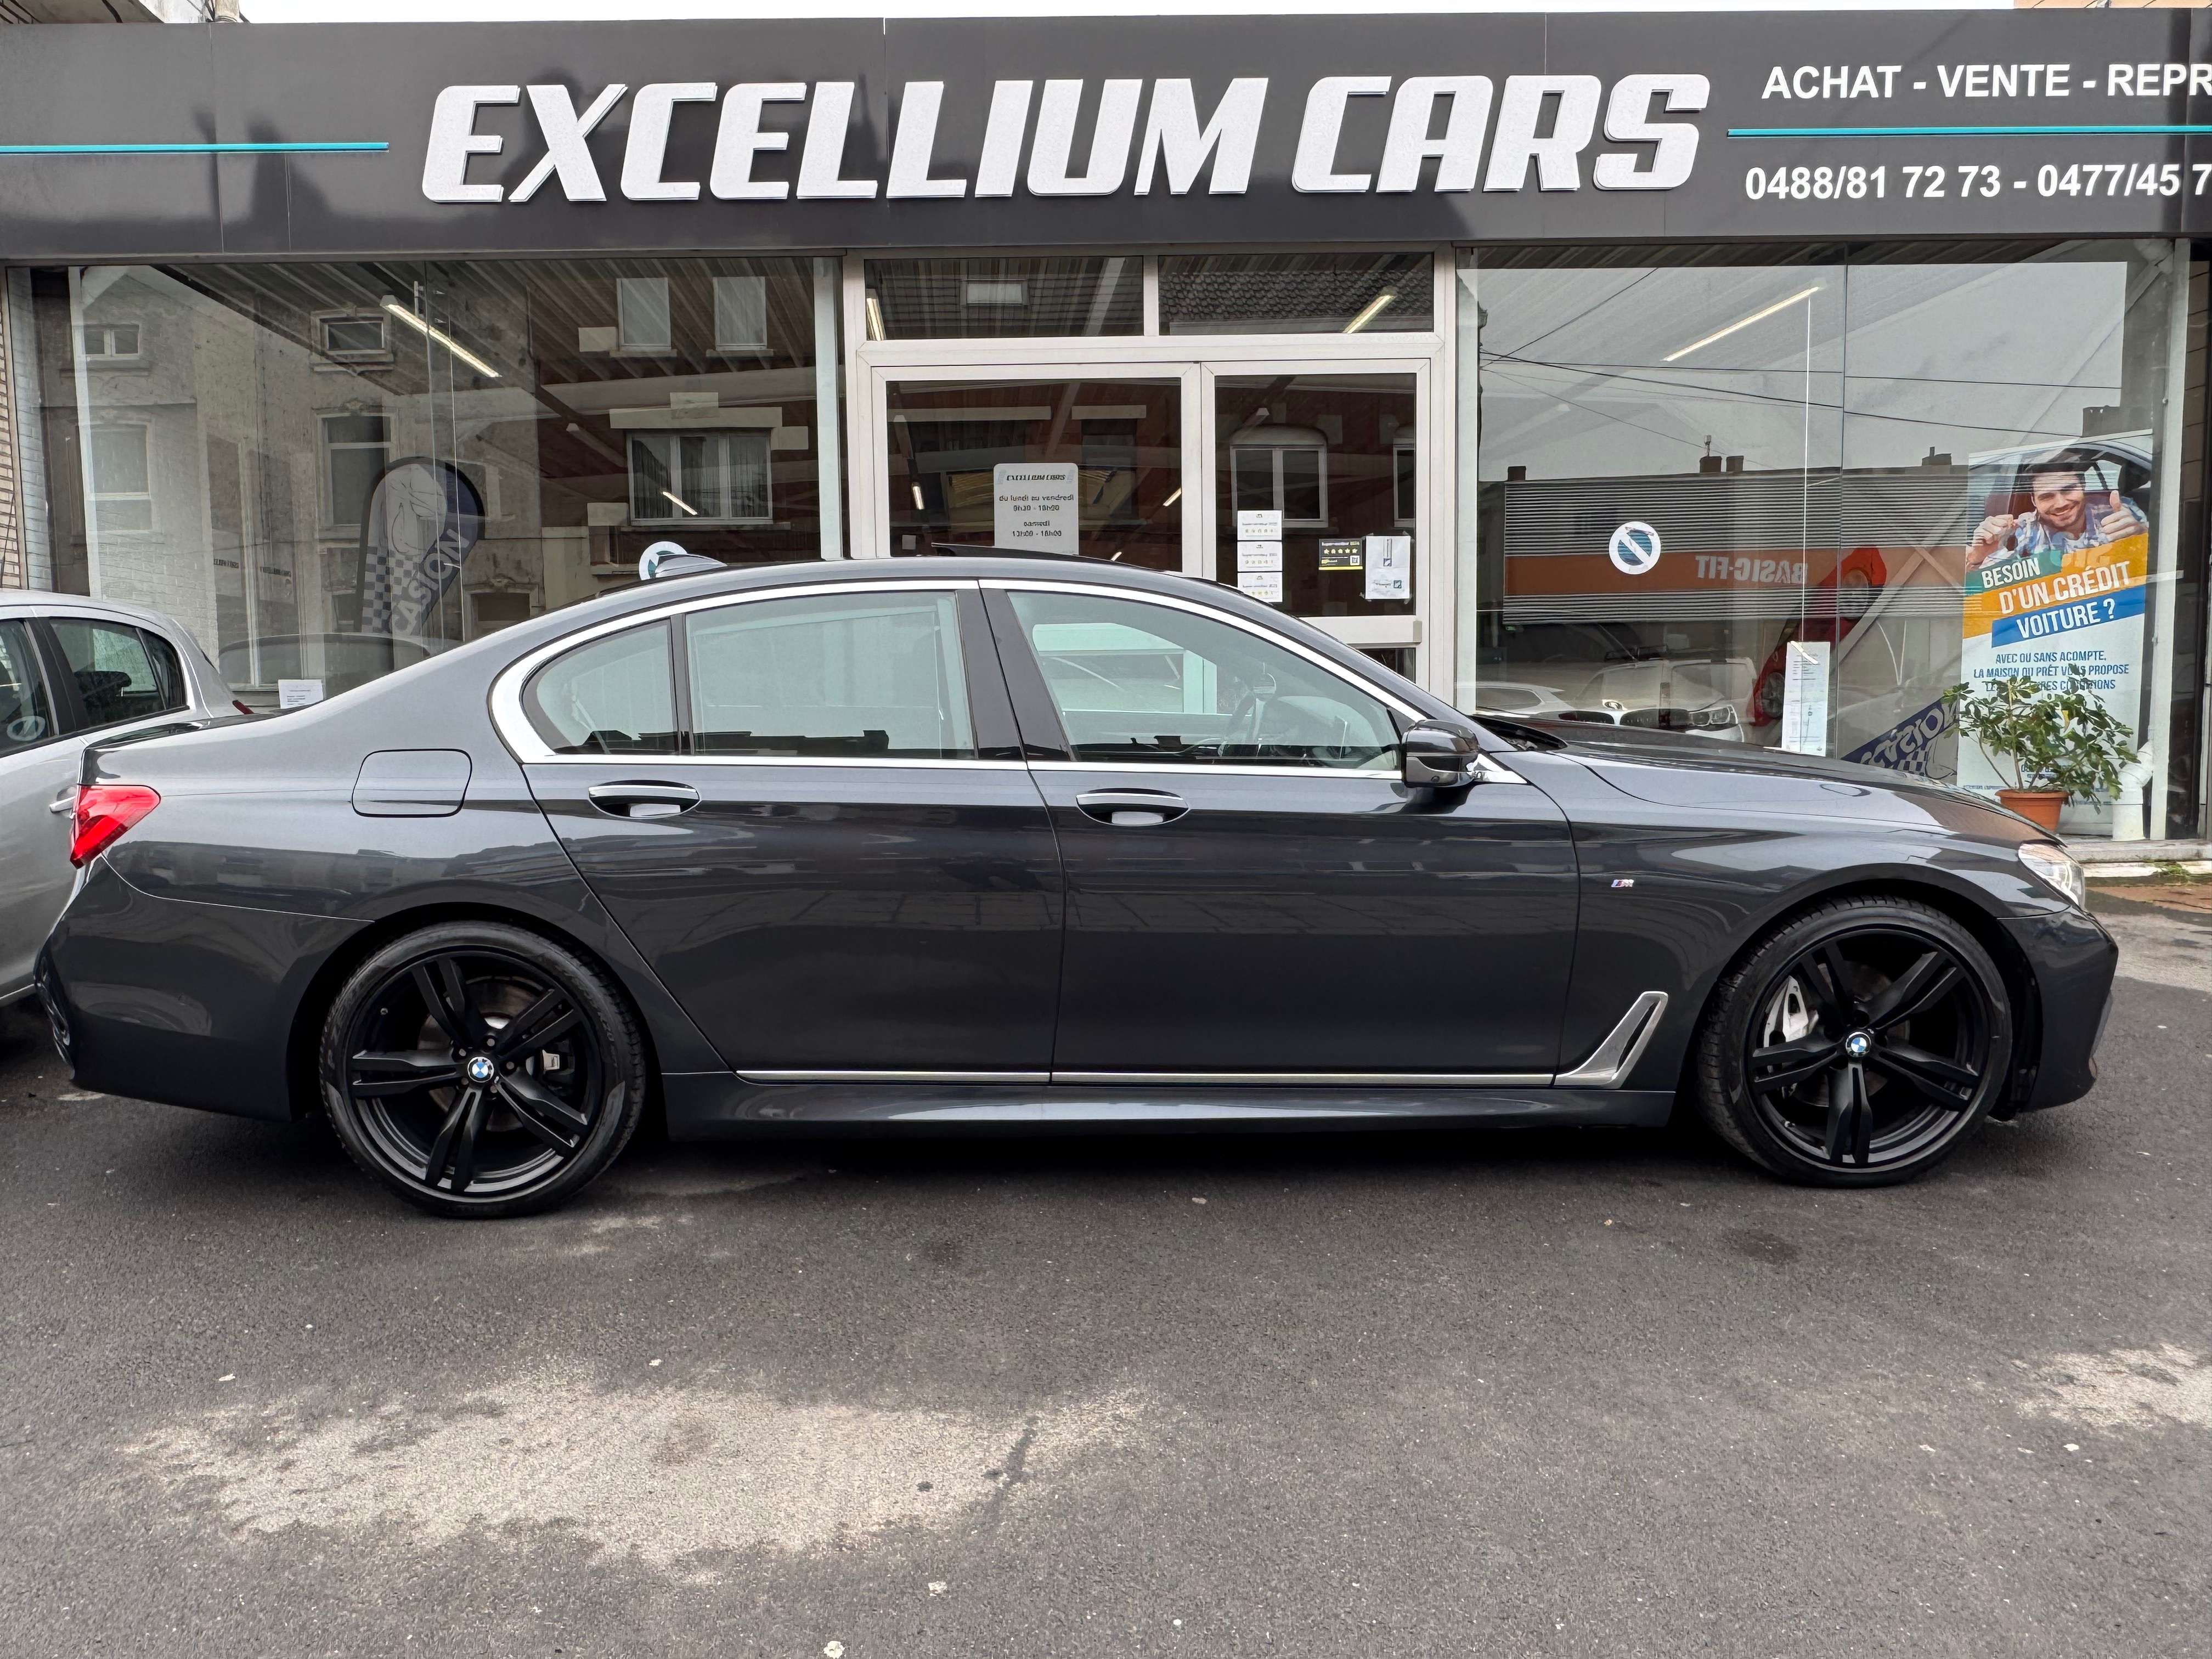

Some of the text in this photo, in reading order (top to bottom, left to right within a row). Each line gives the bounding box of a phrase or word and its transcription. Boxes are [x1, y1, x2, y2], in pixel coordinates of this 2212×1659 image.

[1762, 65, 1901, 99] ACHAT
[1937, 64, 2070, 98] VENTE
[2108, 63, 2212, 97] REPR
[422, 74, 1711, 201] EXCELLIUM CARS
[1745, 166, 1886, 200] 0488/81
[1903, 166, 1945, 198] 72
[1957, 165, 2001, 198] 73
[2037, 163, 2180, 196] 0477/45
[2192, 163, 2212, 195] 7
[1981, 557, 2041, 589] BESOIN
[1998, 561, 2130, 614] D'UN CRÉDIT
[2016, 599, 2116, 639] VOITURE ?
[1974, 668, 1984, 679] LA
[1987, 667, 2019, 678] MAISON
[2089, 664, 2129, 675] PROPOSE
[1996, 651, 2107, 664] AVEC OU SANS ACOMPTE,
